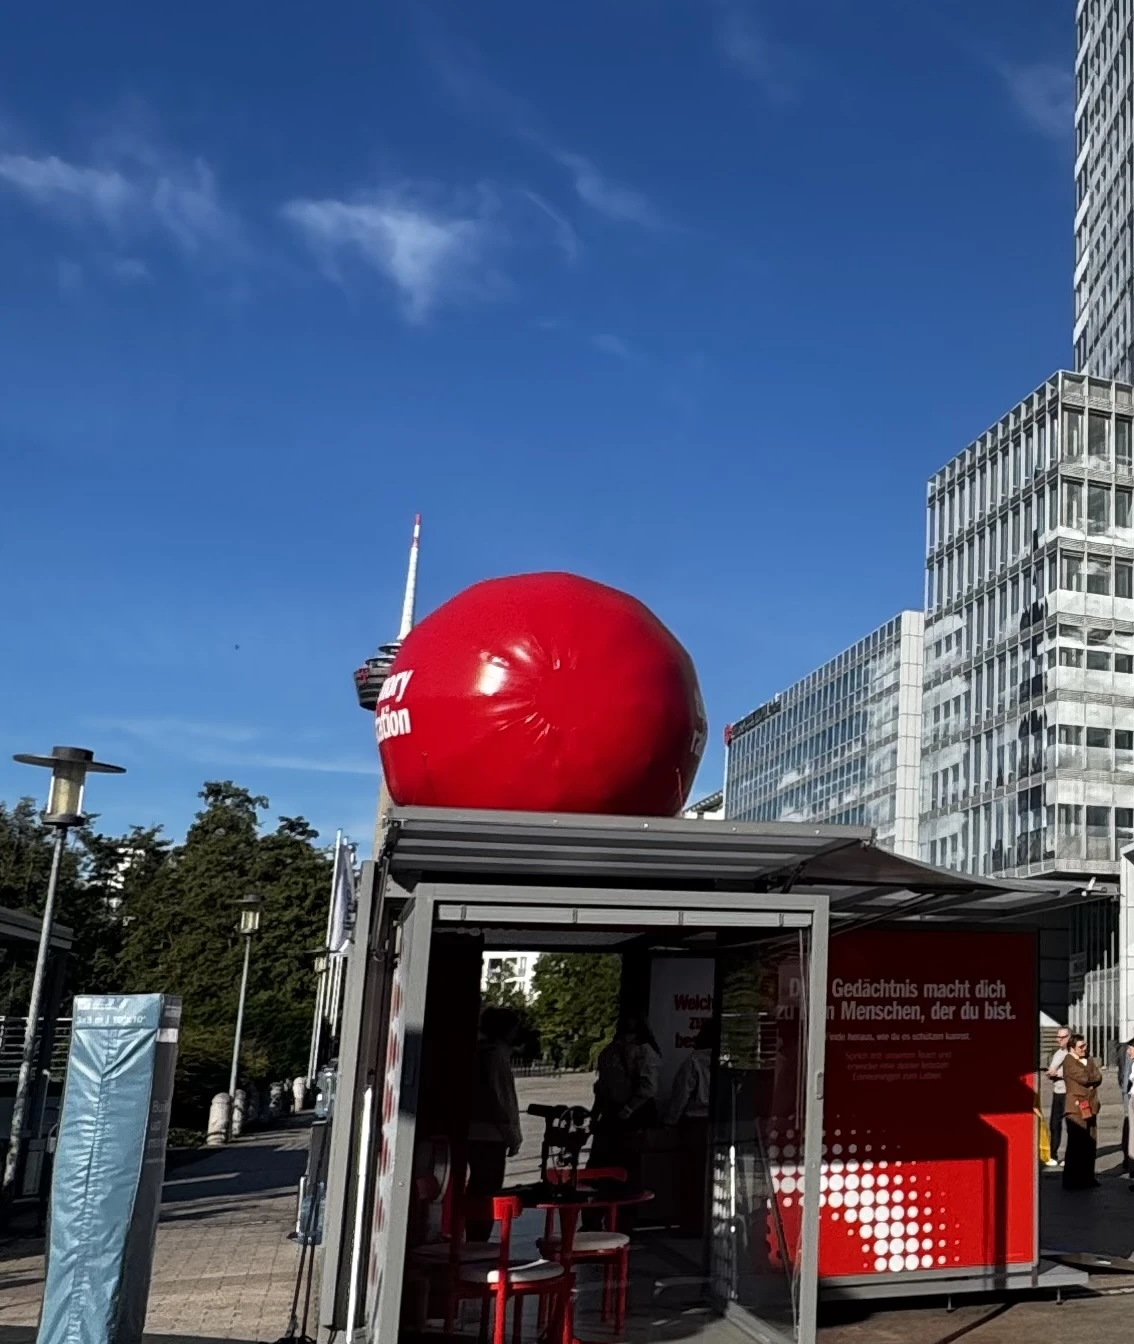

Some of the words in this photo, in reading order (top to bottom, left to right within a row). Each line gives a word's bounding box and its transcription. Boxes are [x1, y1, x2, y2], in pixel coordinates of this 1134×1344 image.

[375, 704, 412, 744] ation
[831, 978, 919, 999] Gedächtnis
[923, 979, 971, 999] macht
[975, 979, 1006, 999] dich
[841, 1001, 925, 1023] Menschen,
[931, 1001, 956, 1021] der
[961, 1001, 979, 1021] du
[984, 1001, 1016, 1021] bist.
